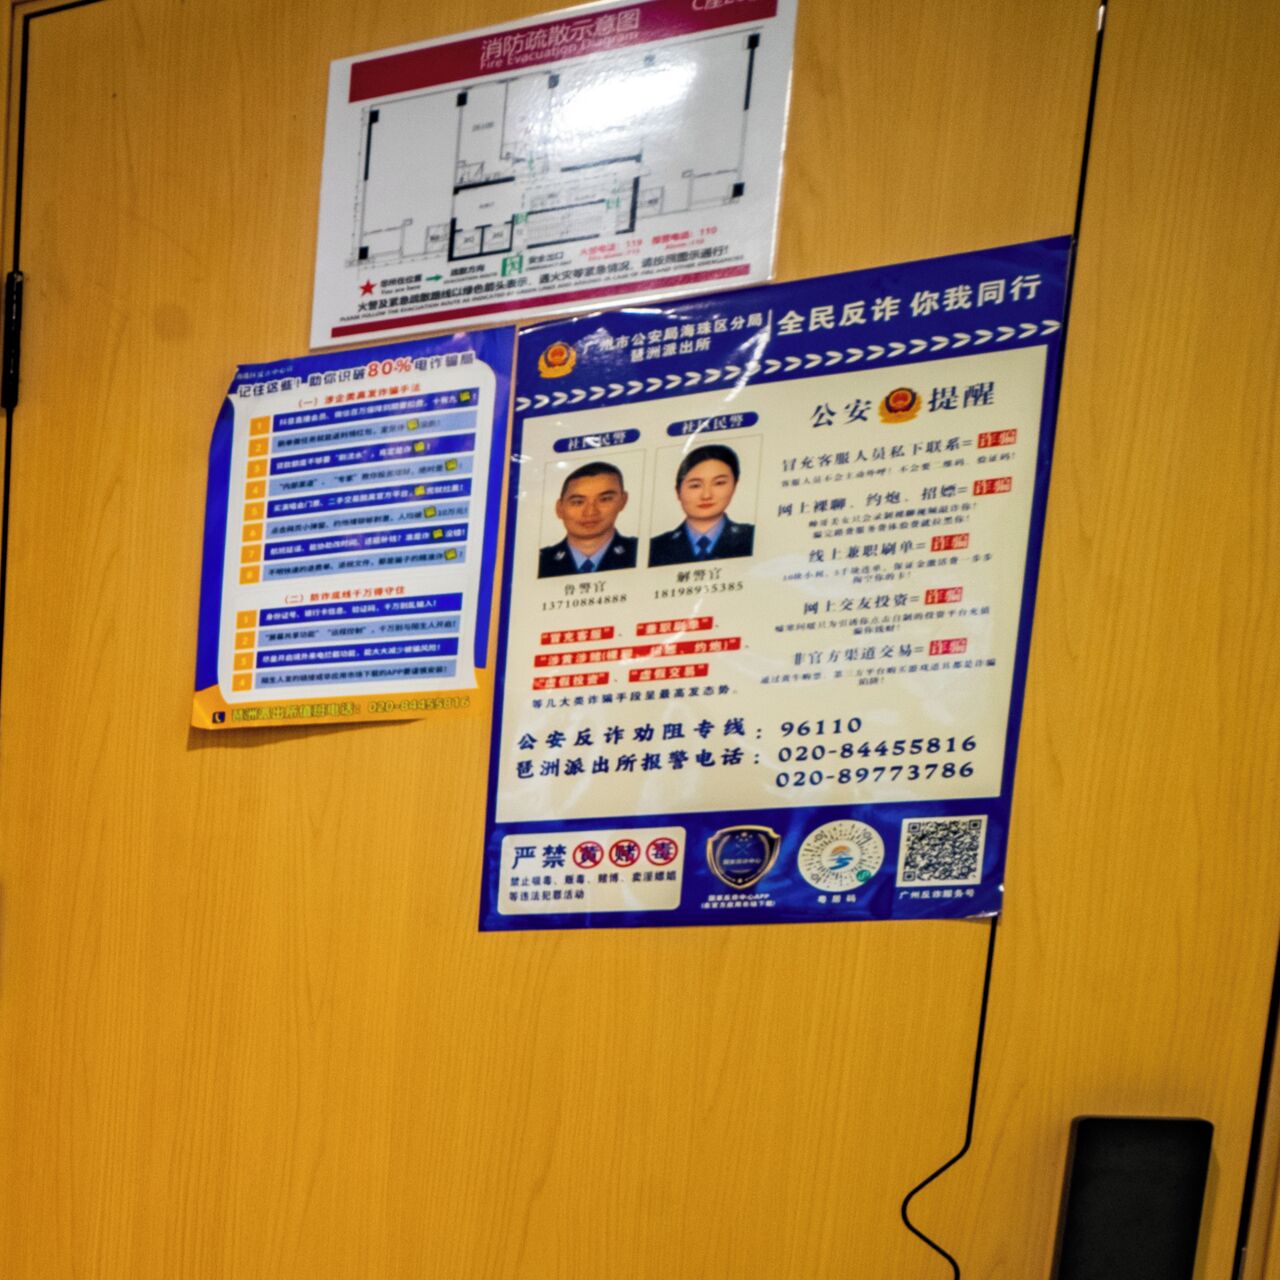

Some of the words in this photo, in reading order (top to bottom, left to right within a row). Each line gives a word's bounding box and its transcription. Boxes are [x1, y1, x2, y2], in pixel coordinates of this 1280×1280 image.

[482, 8, 640, 59] 消防疏散示意图
[480, 55, 503, 70] Fire
[507, 44, 577, 66] Evacuation
[777, 297, 902, 337] 全民反诈
[911, 274, 1043, 315] 你我同行
[582, 311, 764, 355] 广州市公安局海珠区分局
[630, 338, 711, 362] 琶洲派出所
[811, 399, 873, 429] 公安
[927, 380, 996, 410] 提醒
[567, 431, 626, 449] 社民警
[563, 580, 607, 597] 鲁警官
[517, 717, 763, 750] 公安反诈劝阻专线：
[780, 716, 863, 737] 96110
[515, 748, 761, 779] 琶洲派出所报警电话：
[777, 734, 977, 763] 020-84455816
[775, 761, 975, 788] 020-89773786
